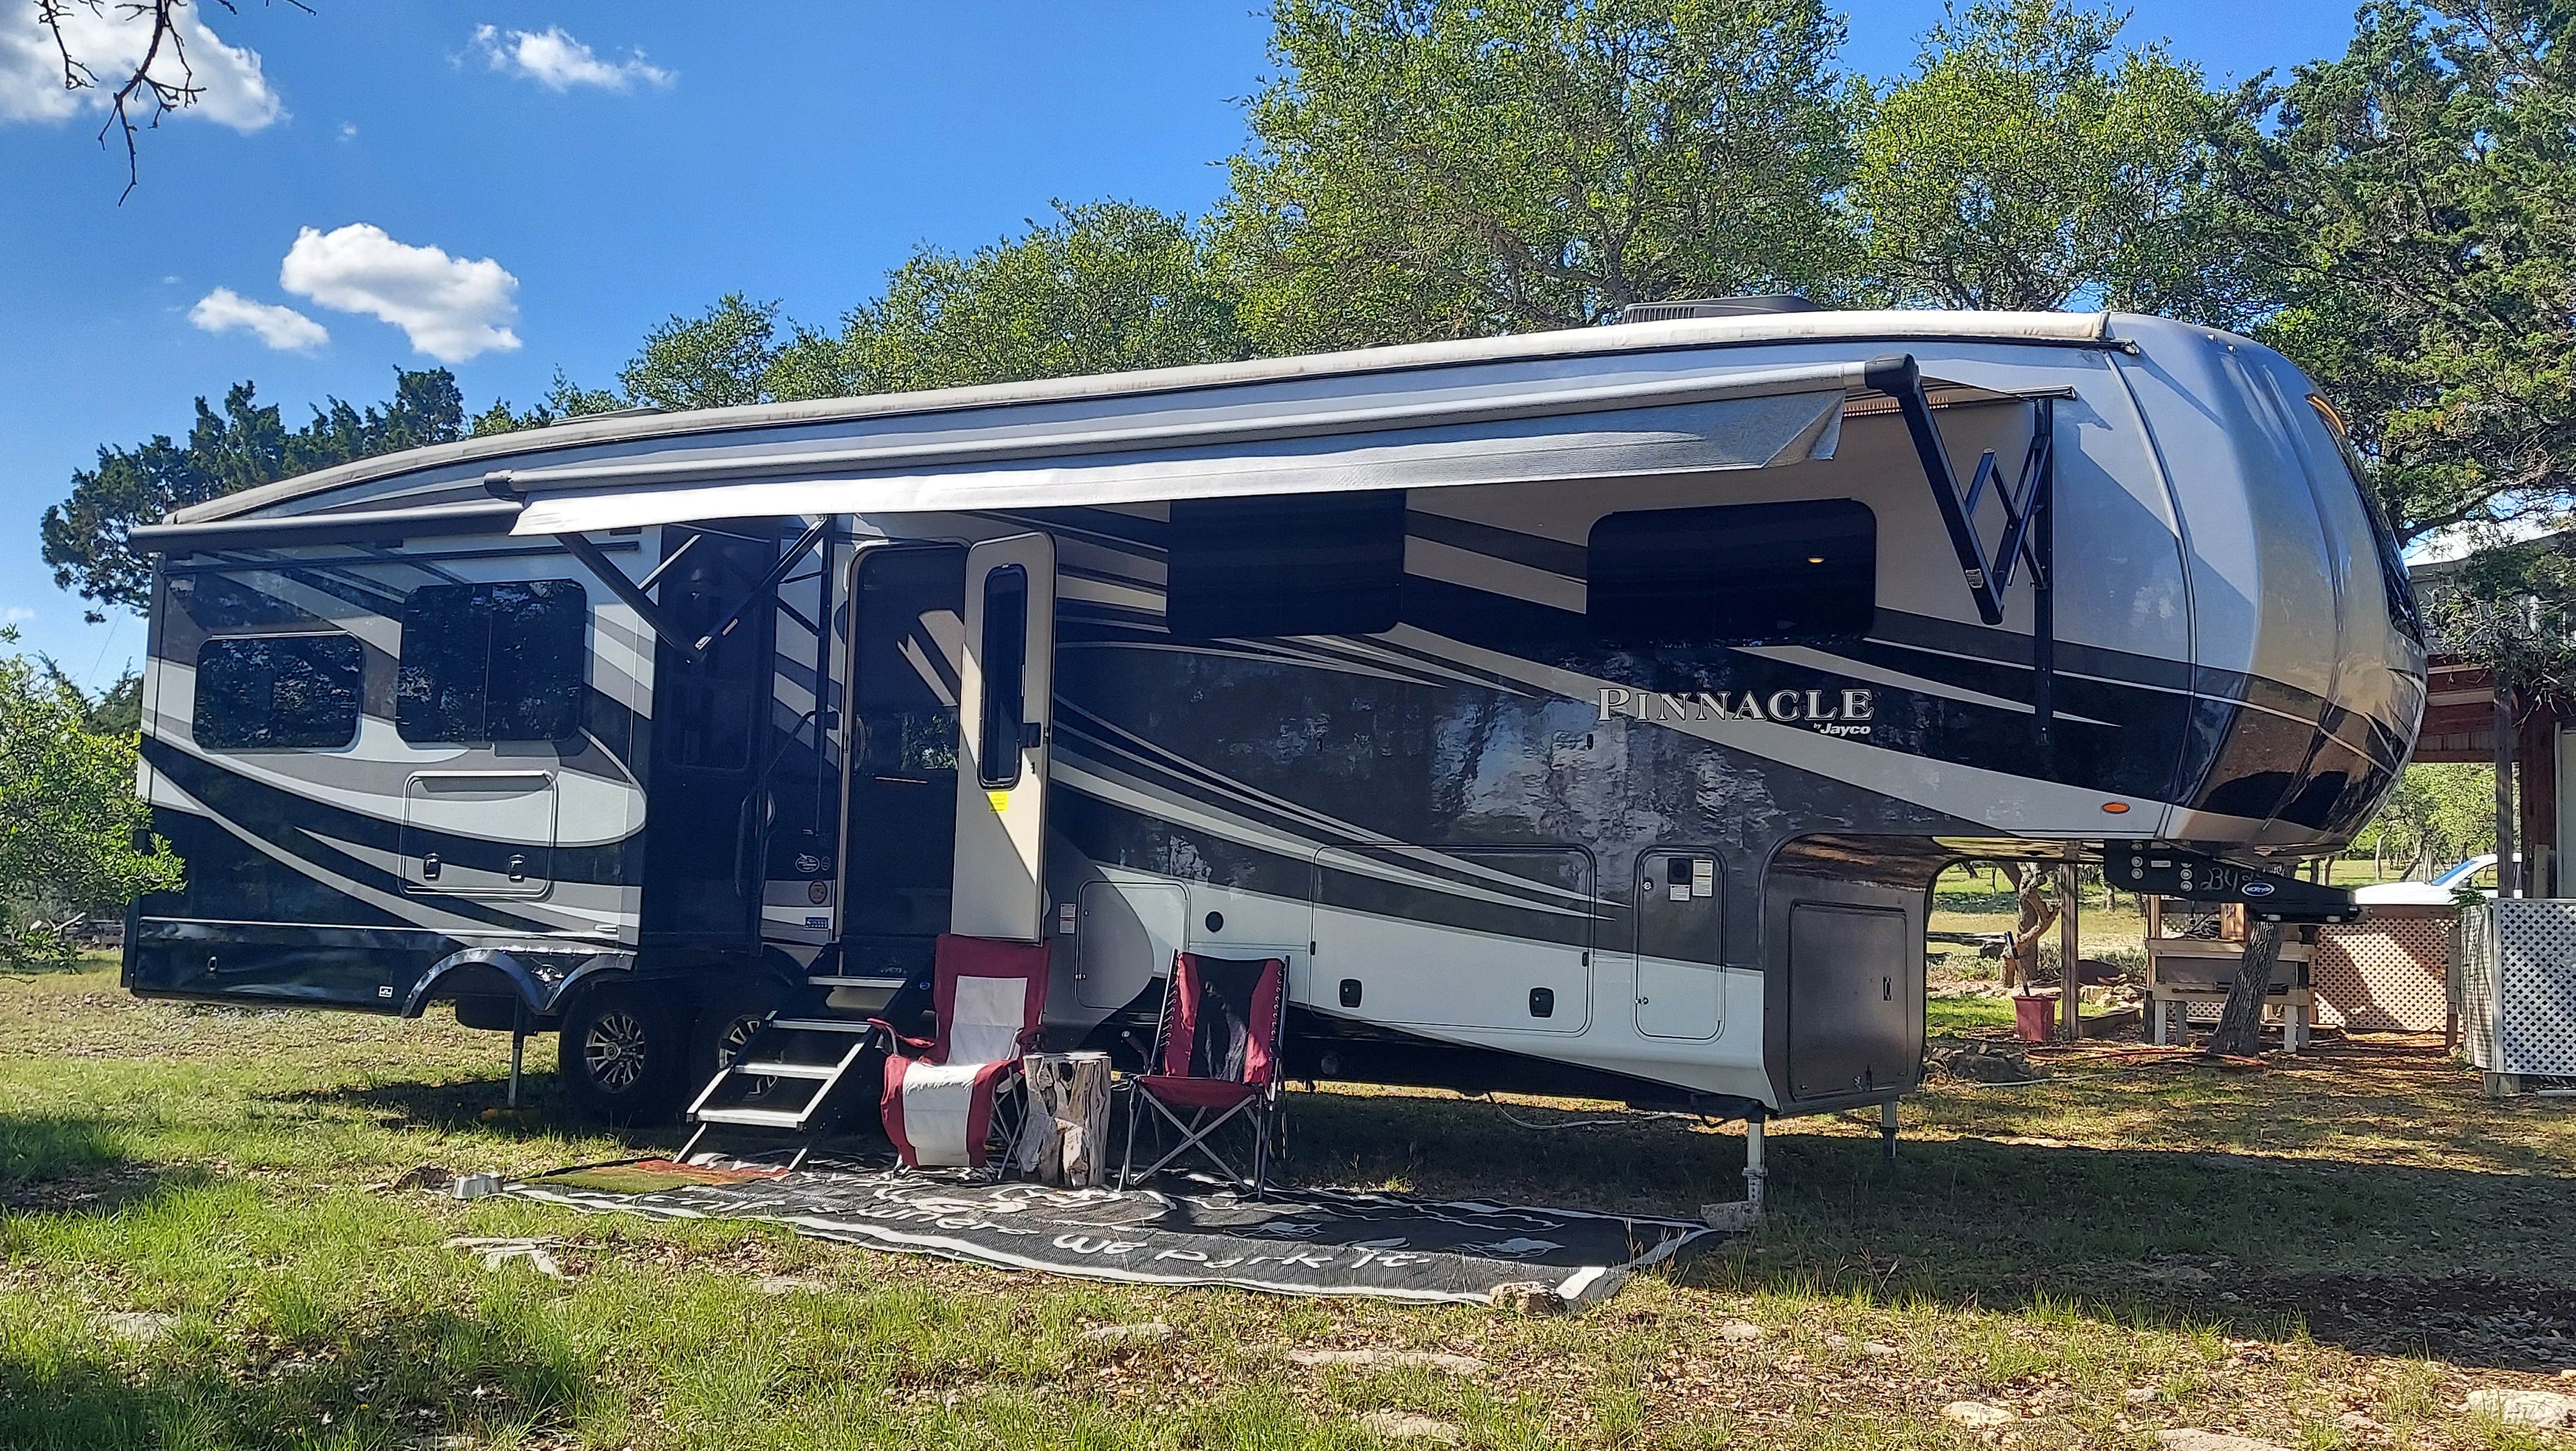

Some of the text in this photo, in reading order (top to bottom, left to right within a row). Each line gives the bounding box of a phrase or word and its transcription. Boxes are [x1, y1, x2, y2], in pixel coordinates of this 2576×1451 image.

[1597, 688, 1874, 723] PINNACLE
[1820, 723, 1871, 737] Jayco
[1155, 1250, 1334, 1269] Park
